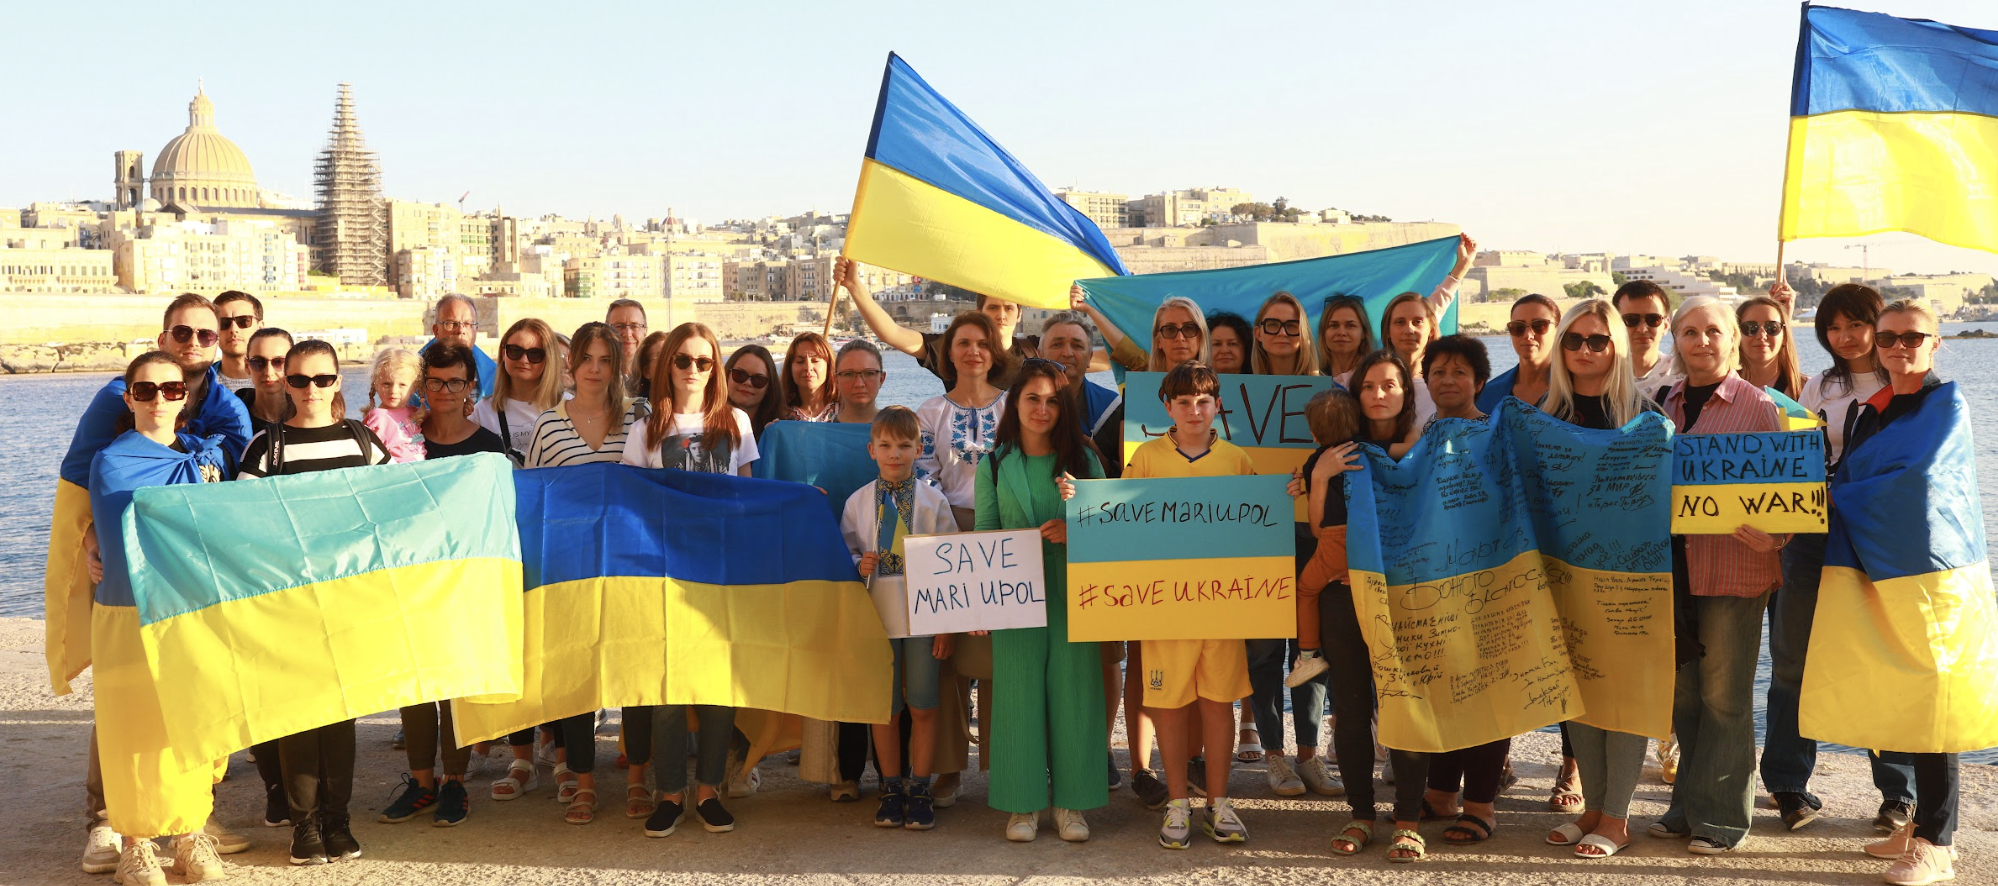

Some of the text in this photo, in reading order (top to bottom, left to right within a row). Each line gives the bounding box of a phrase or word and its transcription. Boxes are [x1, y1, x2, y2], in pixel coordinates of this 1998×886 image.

[1679, 434, 1762, 456] STAND
[1769, 432, 1820, 453] WITH
[1678, 485, 1825, 524] NO WAR!!!
[933, 538, 1018, 575] SAVE
[1174, 575, 1293, 602] UKRAINE
